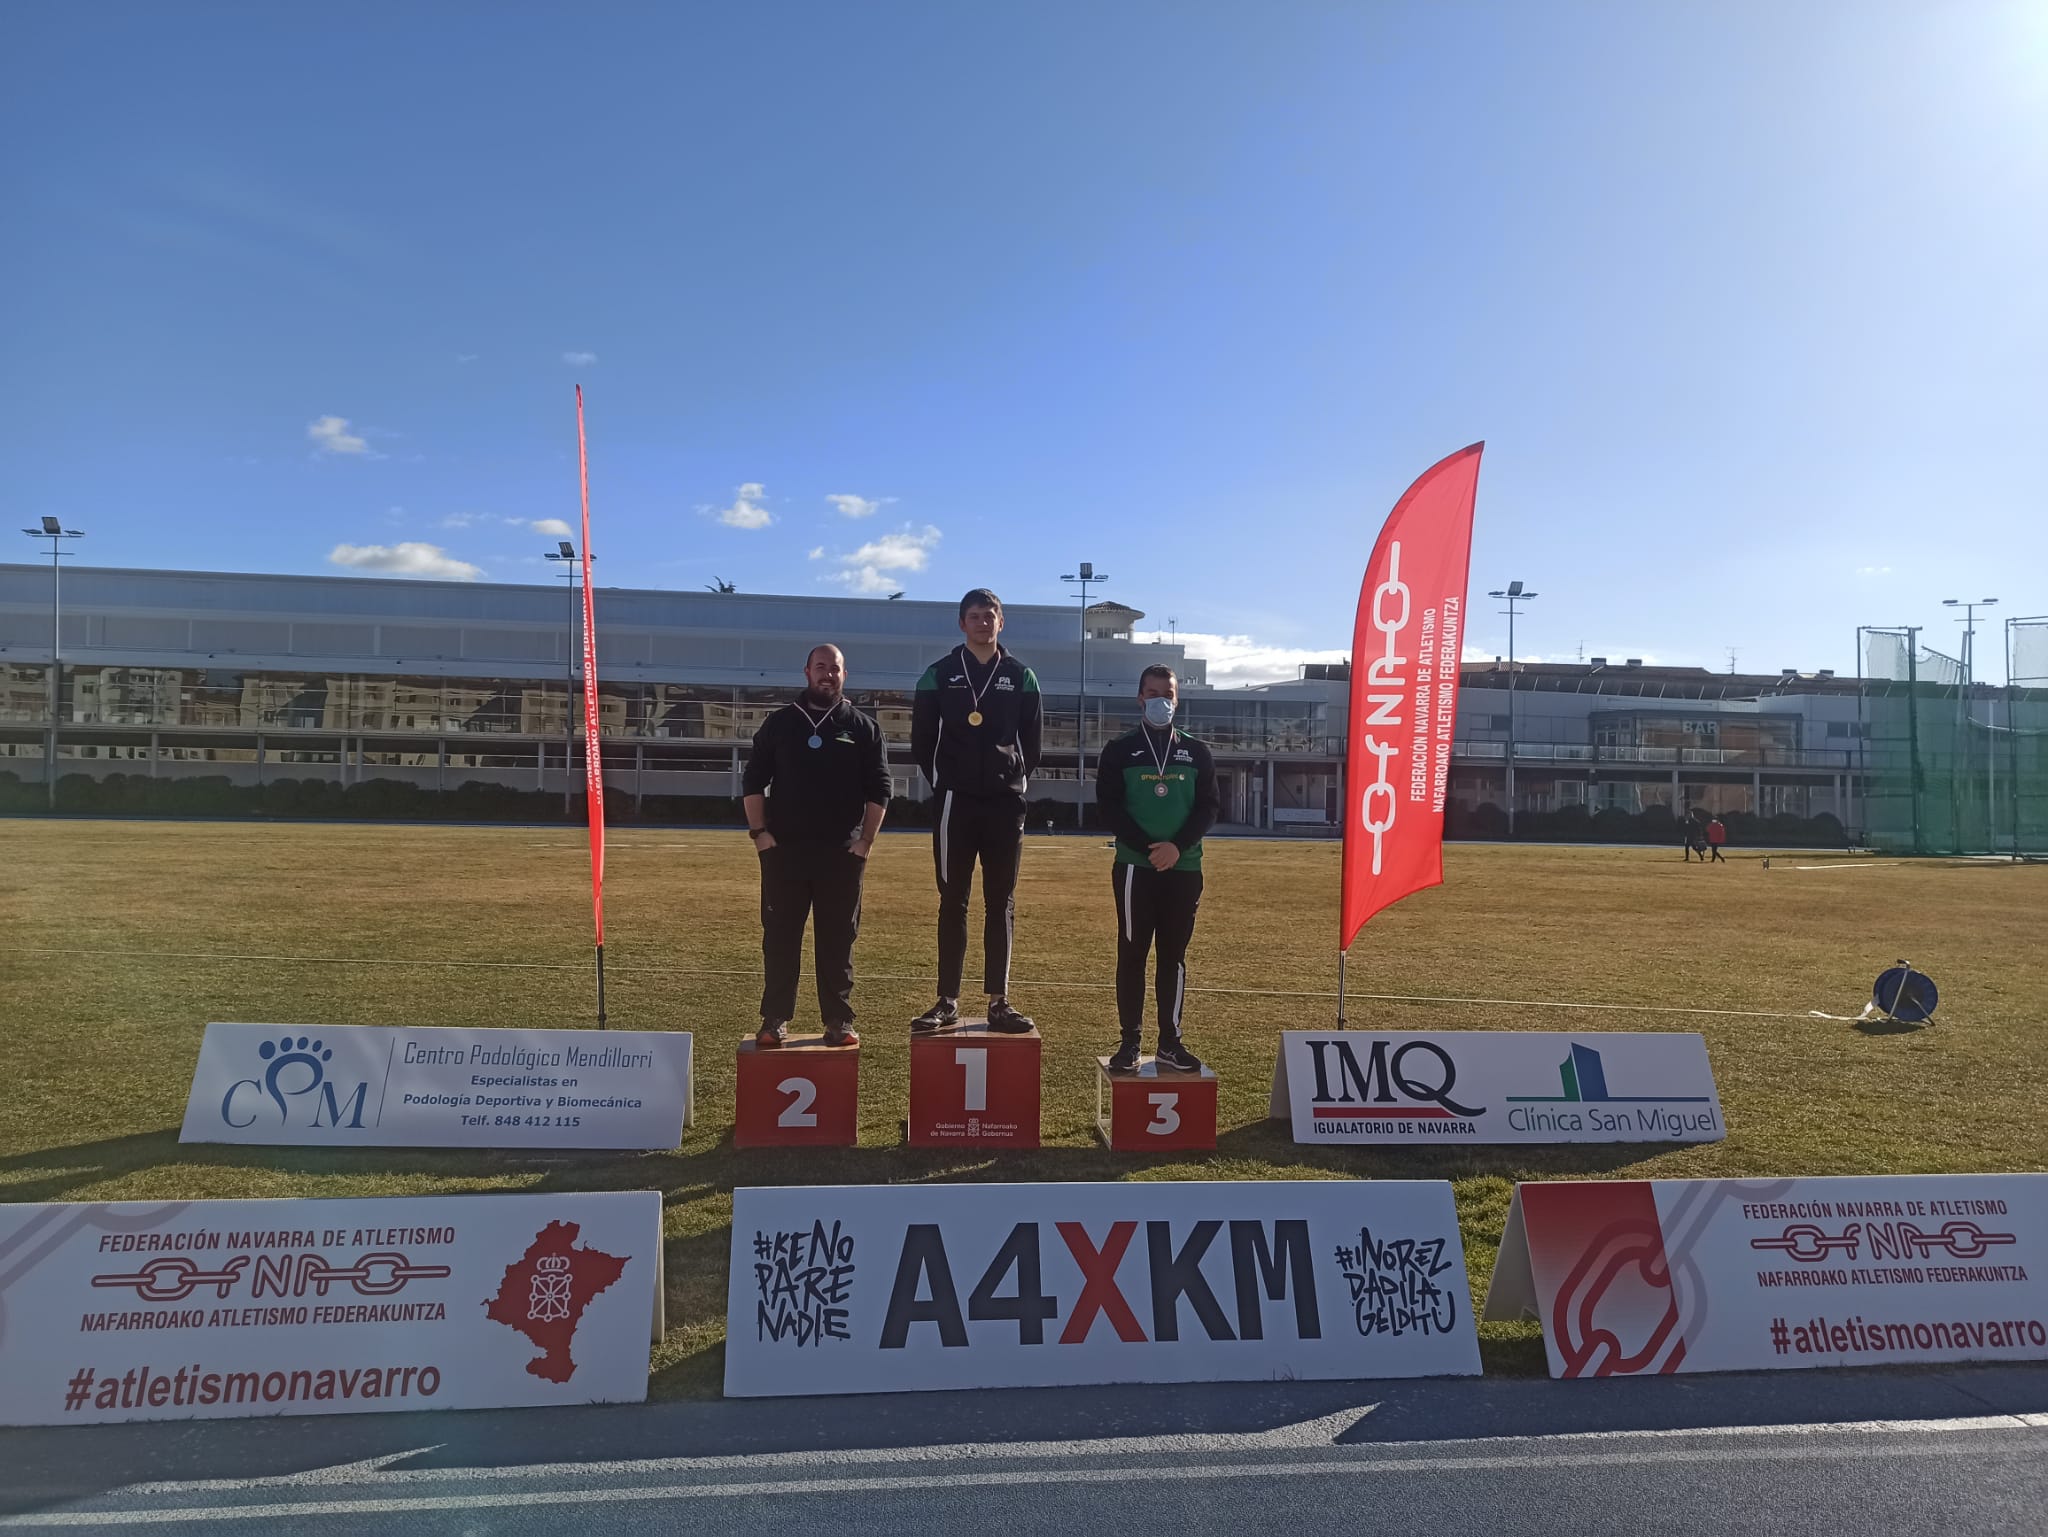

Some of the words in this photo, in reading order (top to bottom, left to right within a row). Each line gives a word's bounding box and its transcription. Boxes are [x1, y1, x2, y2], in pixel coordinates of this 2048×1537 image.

[1419, 608, 1436, 666] ATLETISMO
[1439, 596, 1459, 679] FEDERAKUNTZA
[584, 661, 597, 726] ATLETISMO
[1416, 667, 1432, 682] DE
[1413, 685, 1431, 734] NAVARRA
[1437, 682, 1454, 740] ATLETISMO
[1682, 720, 1718, 735] BAR
[1409, 736, 1428, 802] FEDERACIÓN
[1432, 743, 1450, 813] NAFARROAKO
[404, 1041, 465, 1065] Centro
[470, 1044, 561, 1071] Podológico
[566, 1046, 653, 1068] Mendillorri
[470, 1075, 558, 1088] Especialistas
[561, 1078, 578, 1088] en
[955, 1047, 988, 1111] 1
[1305, 1040, 1486, 1117] IMQ
[403, 1093, 471, 1108] Podología
[475, 1094, 541, 1108] Deportiva
[546, 1098, 554, 1109] y
[557, 1096, 642, 1109] Biomecánica
[461, 1115, 490, 1127] Telf.
[495, 1115, 521, 1127] 848
[524, 1116, 551, 1127] 412
[555, 1116, 581, 1128] 115
[776, 1076, 817, 1127] 2
[1146, 1092, 1181, 1136] 3
[1508, 1107, 1583, 1132] Clínica
[1588, 1108, 1631, 1131] San
[1636, 1107, 1717, 1137] Miguel
[981, 1122, 1018, 1130] Nafarroako
[1314, 1121, 1394, 1134] IGUALATORIO
[1397, 1121, 1413, 1134] DE
[1418, 1121, 1476, 1134] NAVARRA
[1743, 1200, 1833, 1219] FEDERACIÓN
[1836, 1201, 1904, 1218] NAVARRA
[1906, 1201, 1926, 1216] DE
[1930, 1200, 2008, 1216] ATLETISMO
[99, 1229, 220, 1252] FEDERACIÓN
[227, 1231, 316, 1249] NAVARRA
[322, 1229, 347, 1247] DE
[352, 1226, 455, 1246] ATLETISMO
[754, 1257, 855, 1312] PARE
[878, 1219, 1322, 1349] A4XKM
[1342, 1268, 1442, 1311] DADILA
[1757, 1269, 1848, 1287] NAFARROAKO
[1851, 1267, 1924, 1285] ATLETISMO
[1926, 1265, 2029, 1283] FEDERAKUNTZA
[80, 1309, 205, 1332] NAFARROAKO
[208, 1306, 308, 1328] ATLETISMO
[313, 1302, 446, 1324] FEDERAKUNTZA
[757, 1298, 851, 1347] NADIE
[1355, 1291, 1456, 1337] GELDITU
[1770, 1316, 2047, 1355] #atletismonavarro
[64, 1364, 441, 1411] #atletismonavarro
